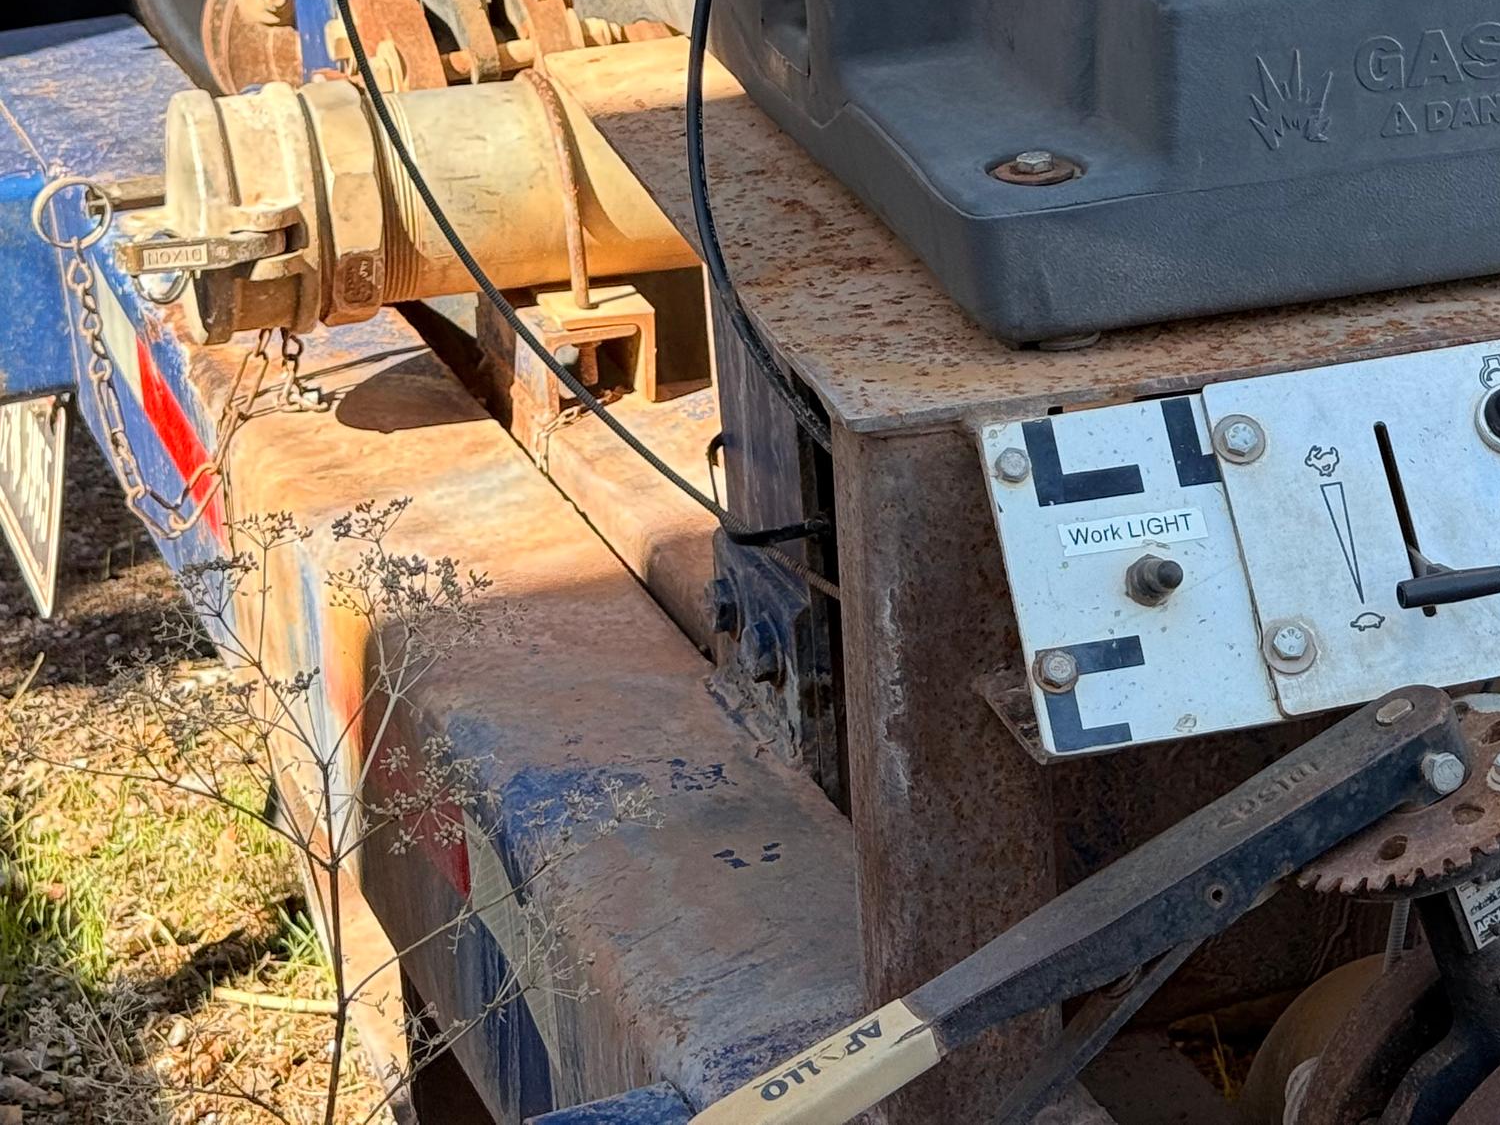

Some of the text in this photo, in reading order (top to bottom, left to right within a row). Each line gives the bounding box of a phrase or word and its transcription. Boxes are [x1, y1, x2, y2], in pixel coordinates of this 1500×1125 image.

[147, 248, 203, 266] DIXON
[1068, 513, 1193, 546] Work LIGHT
